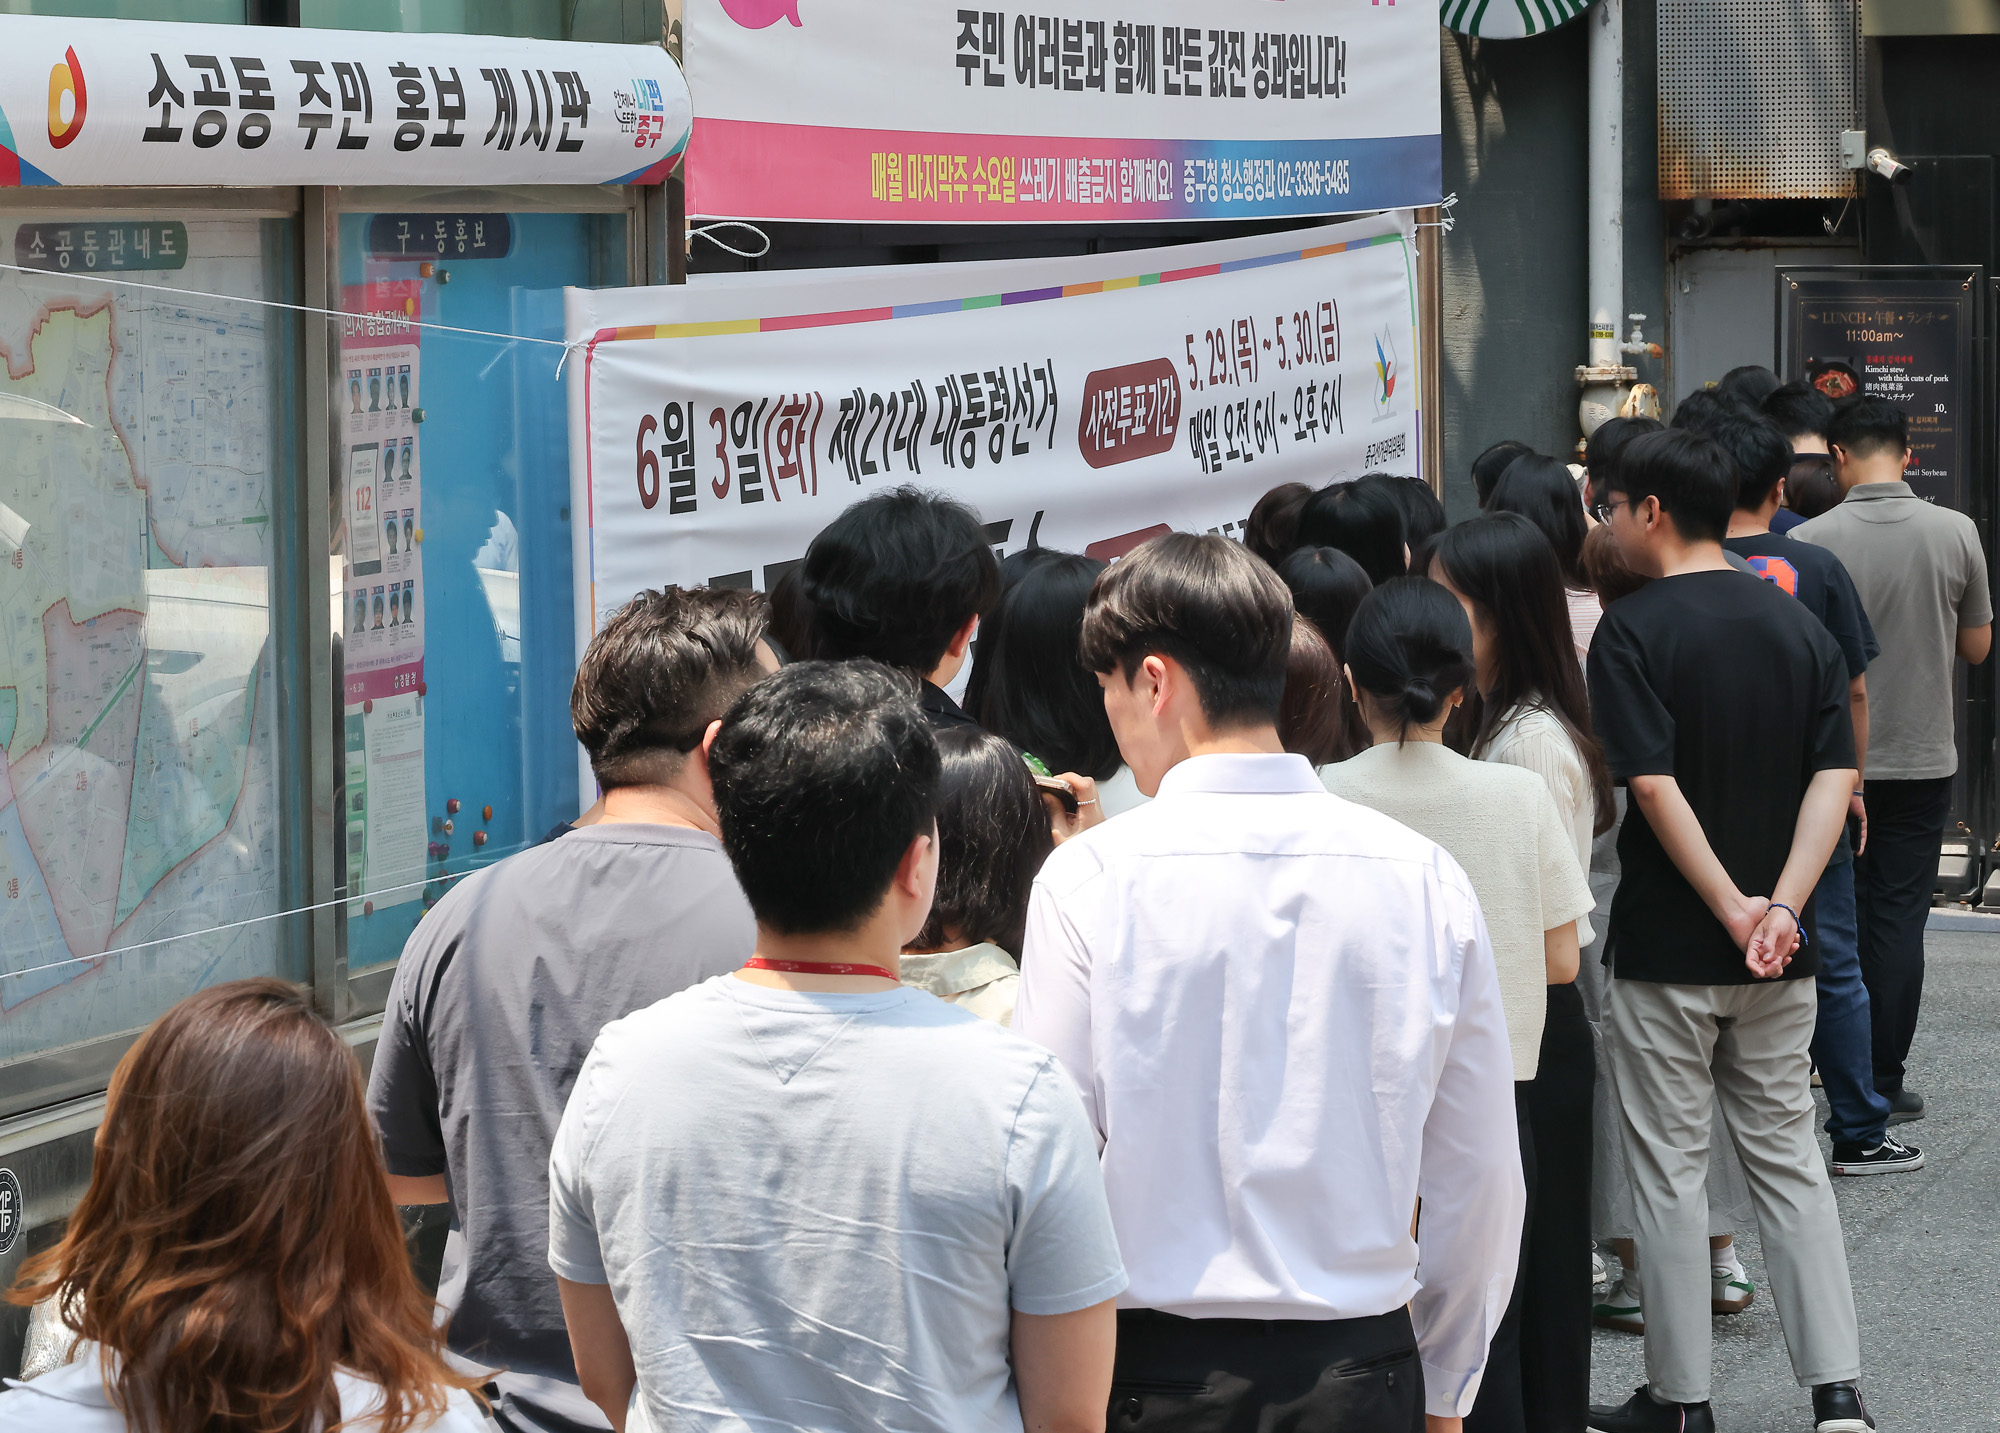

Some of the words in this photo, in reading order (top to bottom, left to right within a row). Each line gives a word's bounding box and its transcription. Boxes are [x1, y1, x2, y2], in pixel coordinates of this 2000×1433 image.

[956, 10, 1005, 88] 주민
[1014, 15, 1108, 93] 여러분과
[1113, 21, 1156, 95] 함께
[1163, 27, 1203, 97] 만든
[1208, 30, 1246, 98] 값진
[1252, 33, 1346, 100] 성과입니다!
[142, 53, 275, 149] 소공동
[289, 59, 373, 150] 주민
[388, 61, 466, 151] 홍보
[479, 68, 592, 153] 게시판
[631, 79, 664, 111] 내편
[634, 115, 664, 148] 중구
[871, 152, 903, 202] 매월
[907, 154, 969, 203] 마지막주
[972, 156, 1016, 204] 수요일
[1019, 157, 1061, 203] 쓰레기
[1064, 156, 1117, 204] 배출금지
[1119, 157, 1174, 204] 함께해요!
[1183, 158, 1218, 203] 중구청
[1220, 158, 1275, 202] 청소행정과
[1276, 159, 1350, 198] 02-3396-5485
[343, 313, 364, 338] 의자
[1822, 311, 1866, 325] LUNCH
[1864, 365, 1889, 373] Kimchi
[1878, 373, 1893, 382] with
[1893, 373, 1910, 382] thick
[1925, 374, 1933, 382] of
[1933, 374, 1949, 384] pork
[1085, 374, 1177, 451] 사전투표기간
[1189, 404, 1222, 474] 매일
[1224, 397, 1254, 463] 오전
[1254, 390, 1280, 455] 6시
[1293, 378, 1319, 443] 오후
[1321, 373, 1344, 435] 6시
[636, 401, 698, 515] 6월
[708, 390, 824, 505] 3일(화)
[828, 379, 926, 486] 제21대
[930, 358, 1059, 470] 대통령선거
[1903, 468, 1920, 476] Snail
[1921, 468, 1948, 477] Soybean
[355, 485, 372, 512] 112
[399, 671, 417, 688] 경찰청
